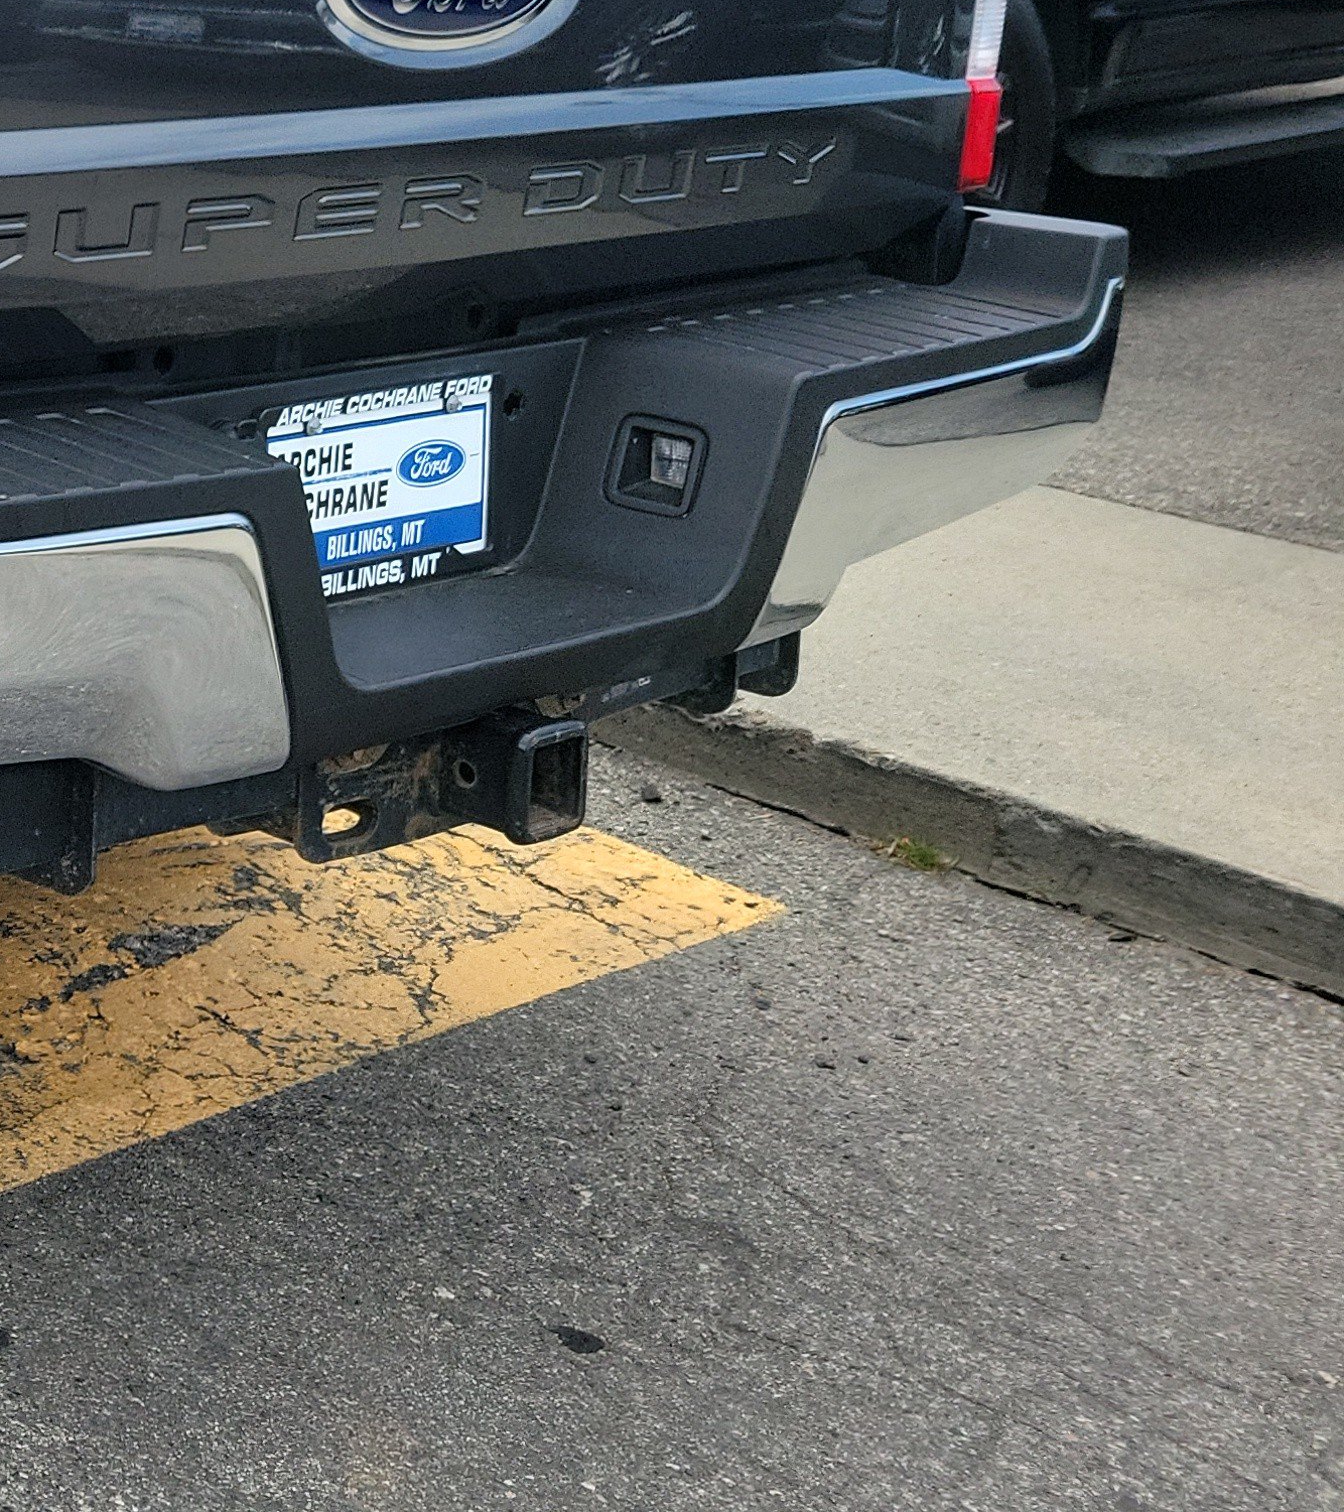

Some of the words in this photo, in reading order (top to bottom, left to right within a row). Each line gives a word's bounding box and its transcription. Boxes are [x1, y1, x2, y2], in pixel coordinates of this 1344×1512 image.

[522, 138, 838, 217] DUTY
[275, 396, 346, 428] ARCHIE
[346, 381, 444, 415] COCHRANE
[444, 374, 492, 399] FORD
[410, 446, 452, 480] Ford
[326, 525, 397, 561] BILLINGS,
[401, 519, 426, 547] MT
[321, 559, 406, 597] BILLINGS,
[411, 551, 442, 579] MT
